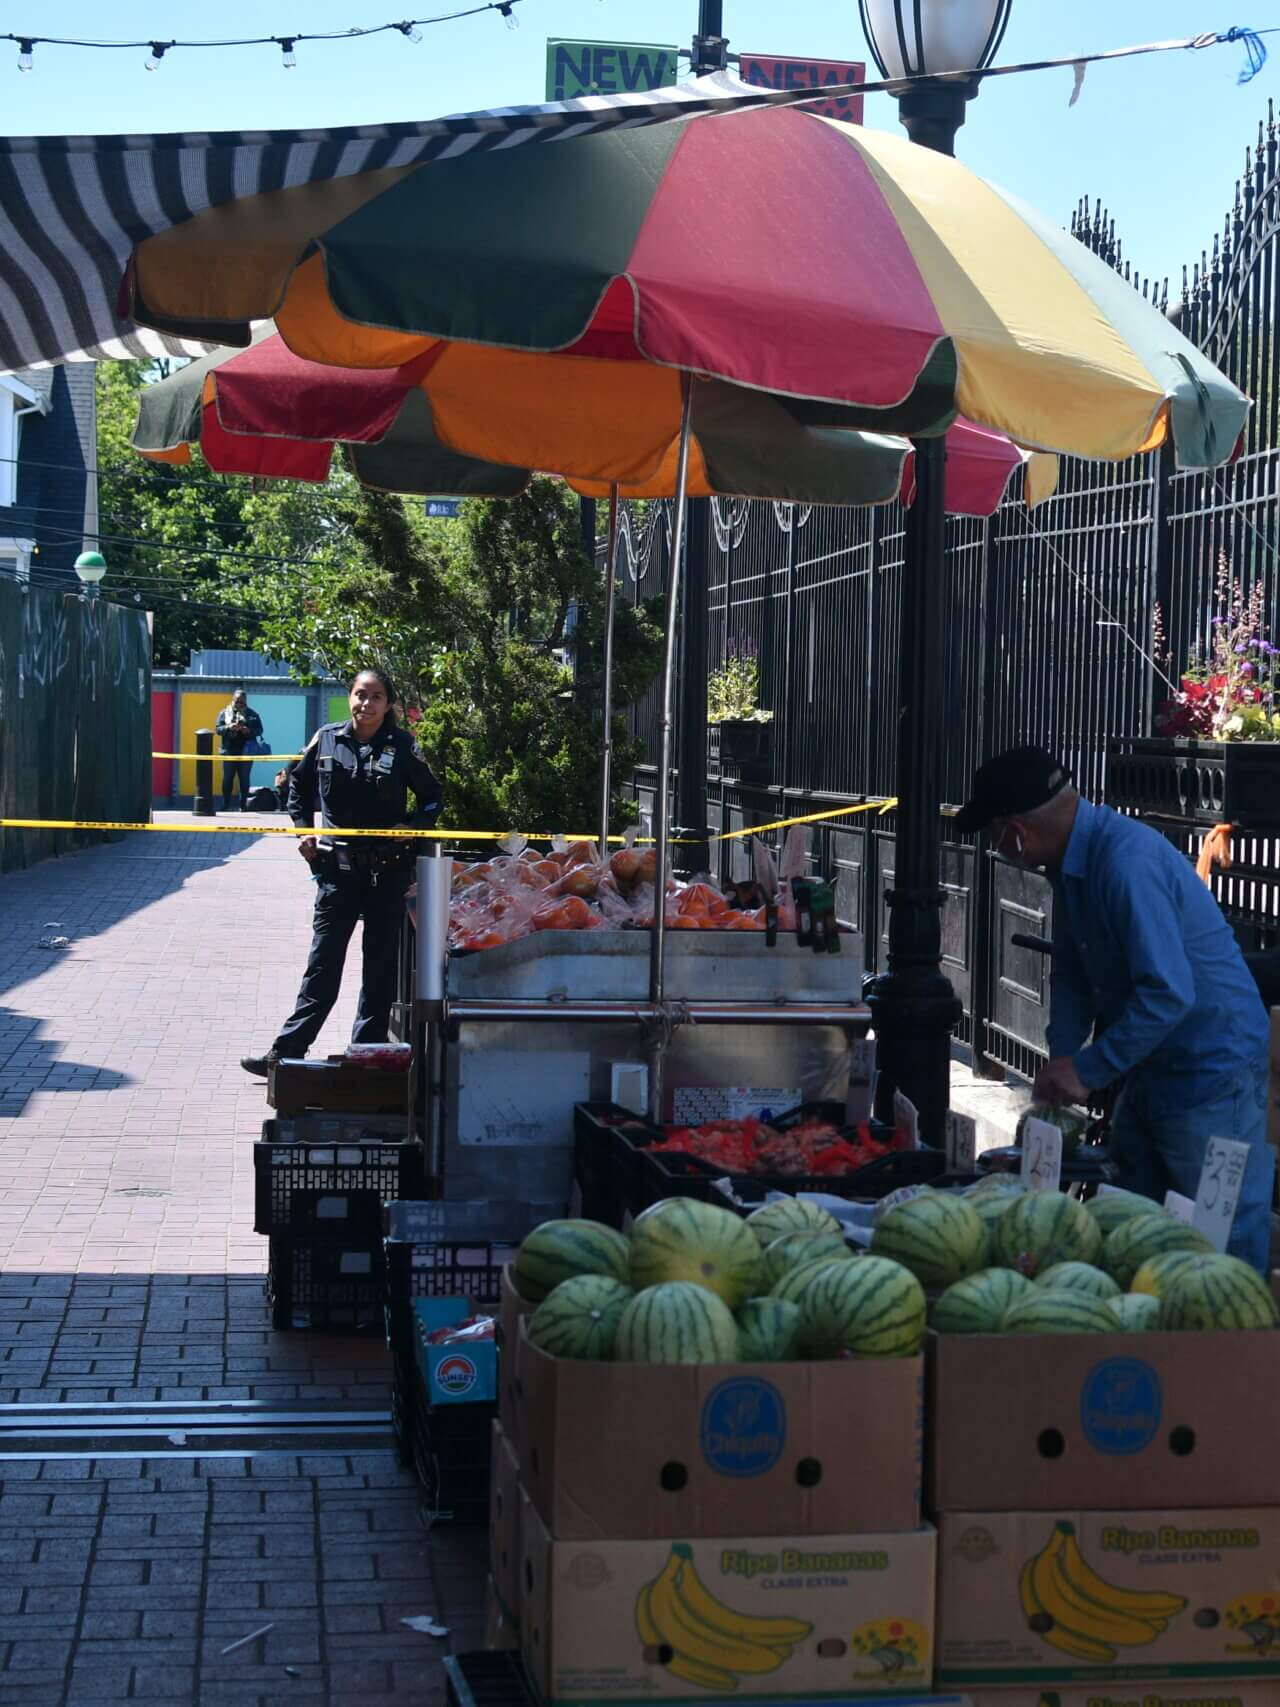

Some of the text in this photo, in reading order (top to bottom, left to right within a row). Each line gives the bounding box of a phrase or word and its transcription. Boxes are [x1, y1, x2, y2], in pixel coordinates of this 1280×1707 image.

[555, 46, 668, 90] NEW
[1102, 1525, 1260, 1554] Ripe Bananas
[721, 1547, 889, 1579] Ripe Bananas
[802, 1575, 848, 1589] EXTRA
